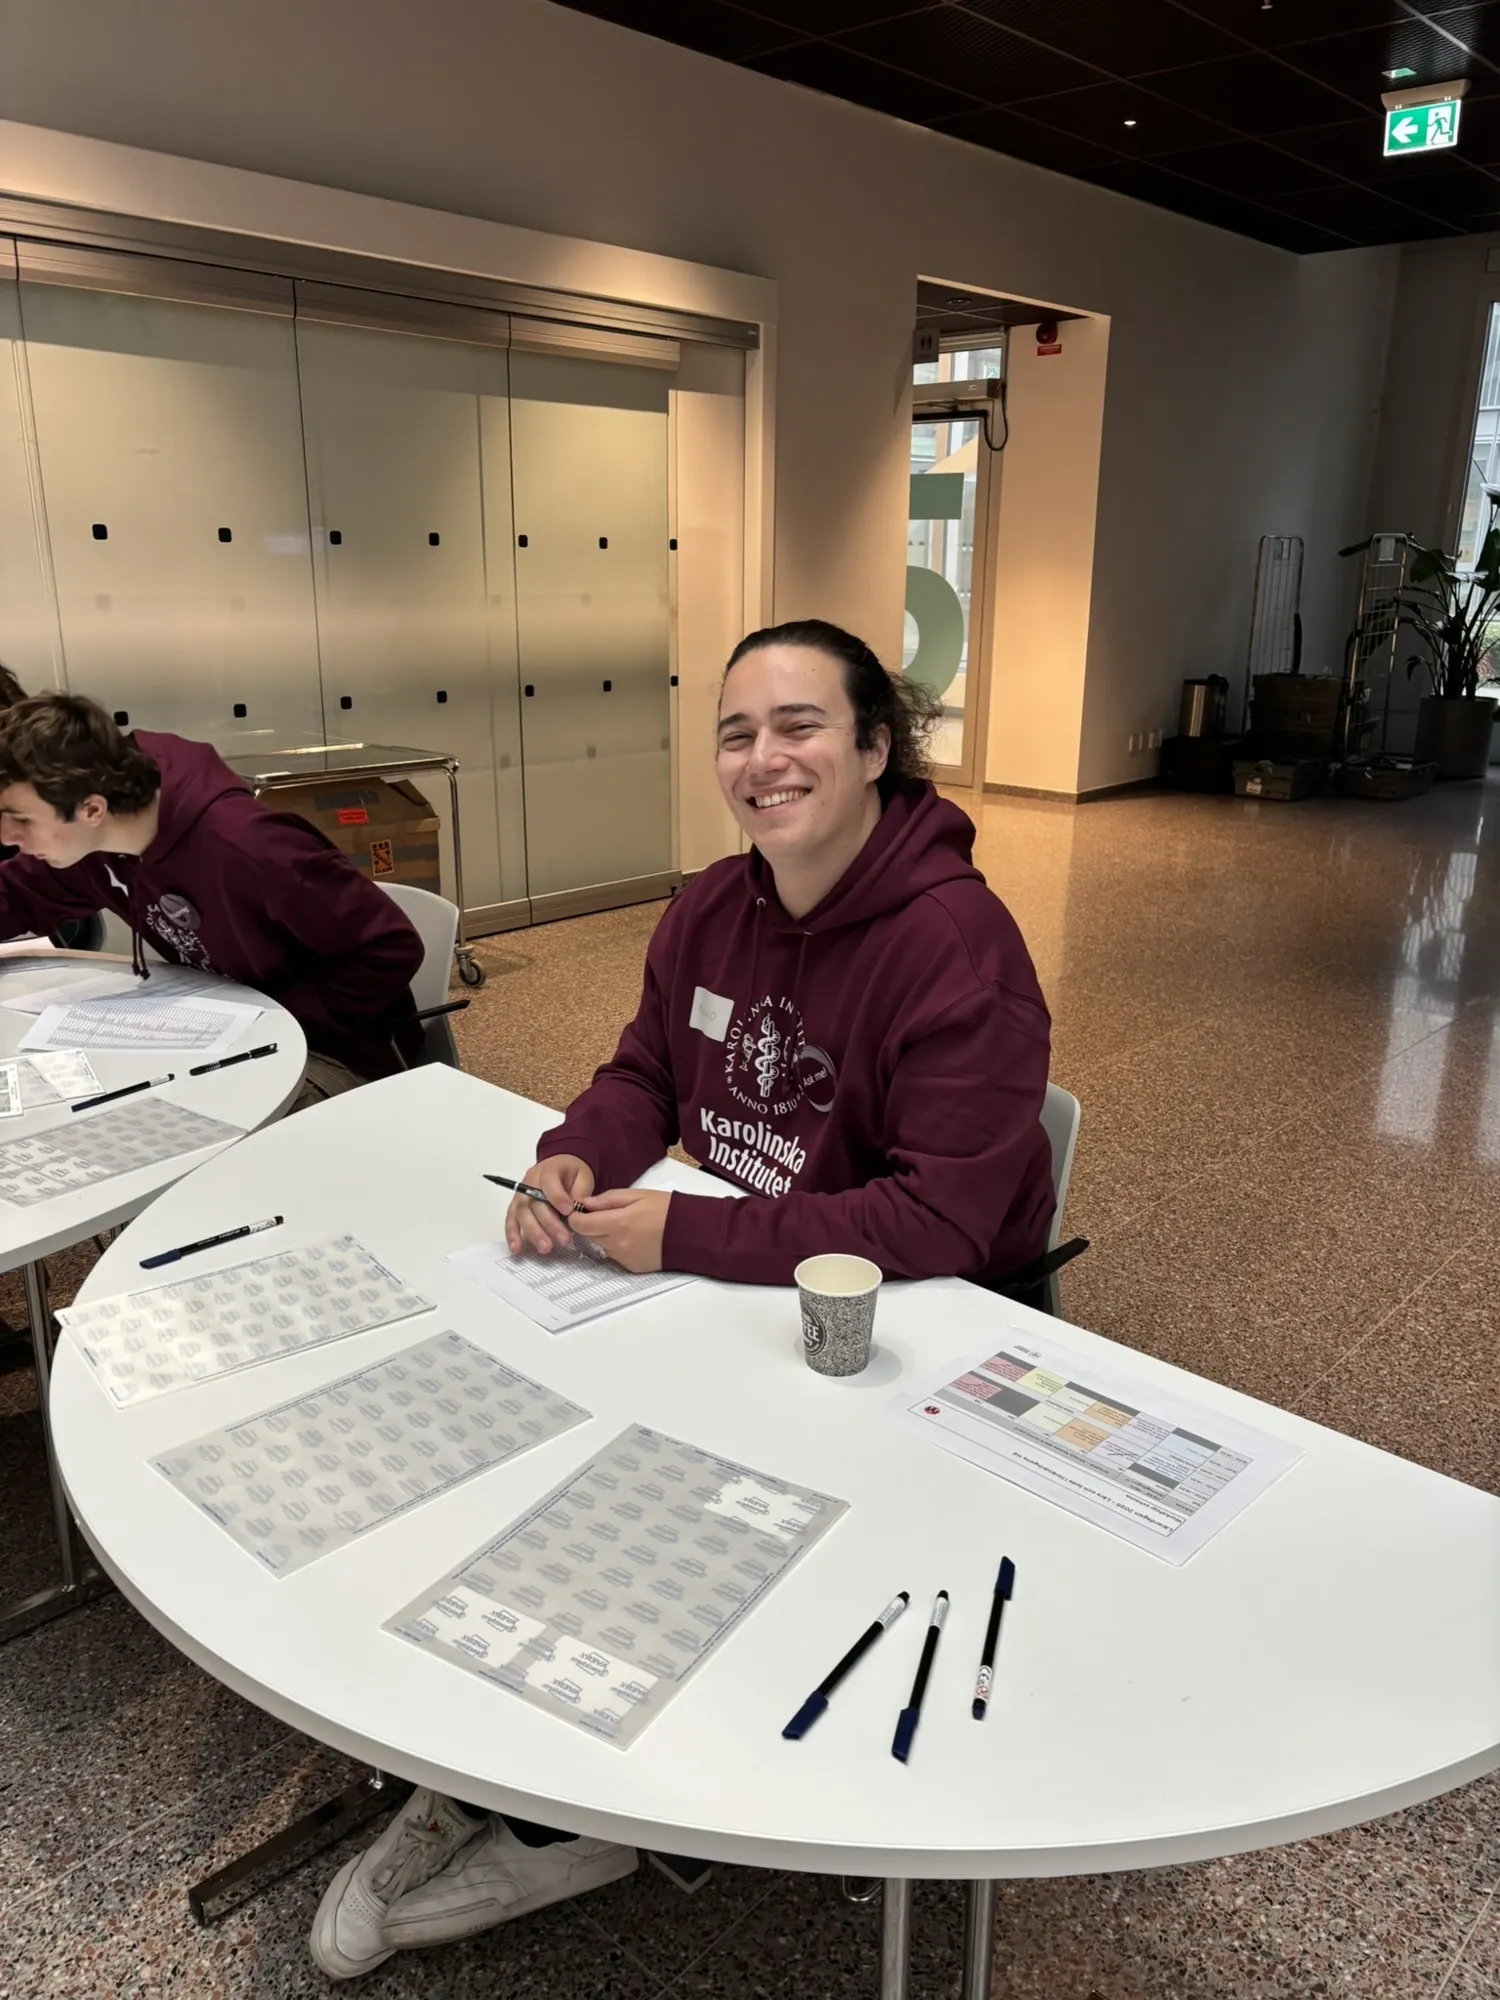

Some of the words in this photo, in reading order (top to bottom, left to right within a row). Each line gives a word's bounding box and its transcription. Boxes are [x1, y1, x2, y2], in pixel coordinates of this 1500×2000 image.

[729, 1086, 768, 1115] ANNO
[773, 1098, 798, 1115] 1810
[700, 1107, 806, 1174] Karolinska
[708, 1135, 792, 1199] Institutet
